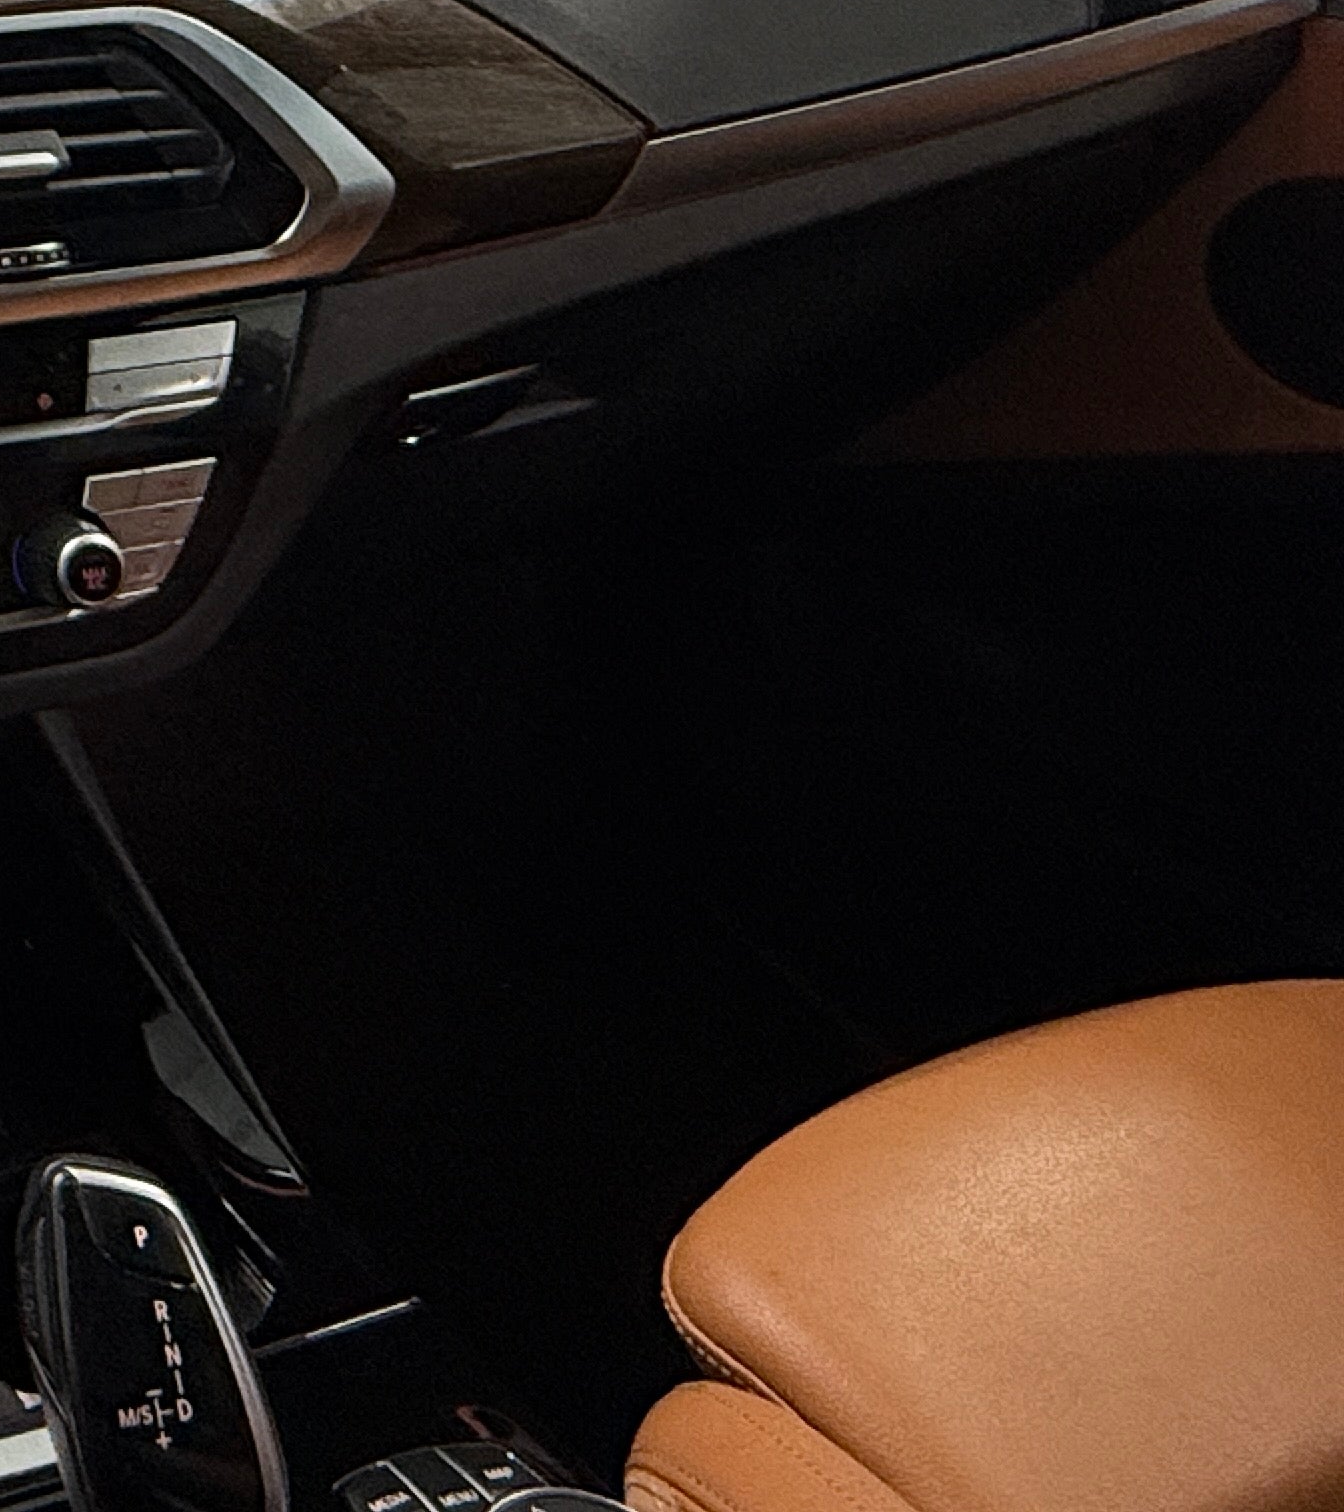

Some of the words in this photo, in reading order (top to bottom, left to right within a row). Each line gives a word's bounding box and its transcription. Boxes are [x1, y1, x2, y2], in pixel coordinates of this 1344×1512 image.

[133, 1225, 148, 1249] P
[153, 1300, 171, 1323] R
[165, 1342, 182, 1368] N
[118, 1404, 154, 1429] M/S
[176, 1398, 193, 1422] D
